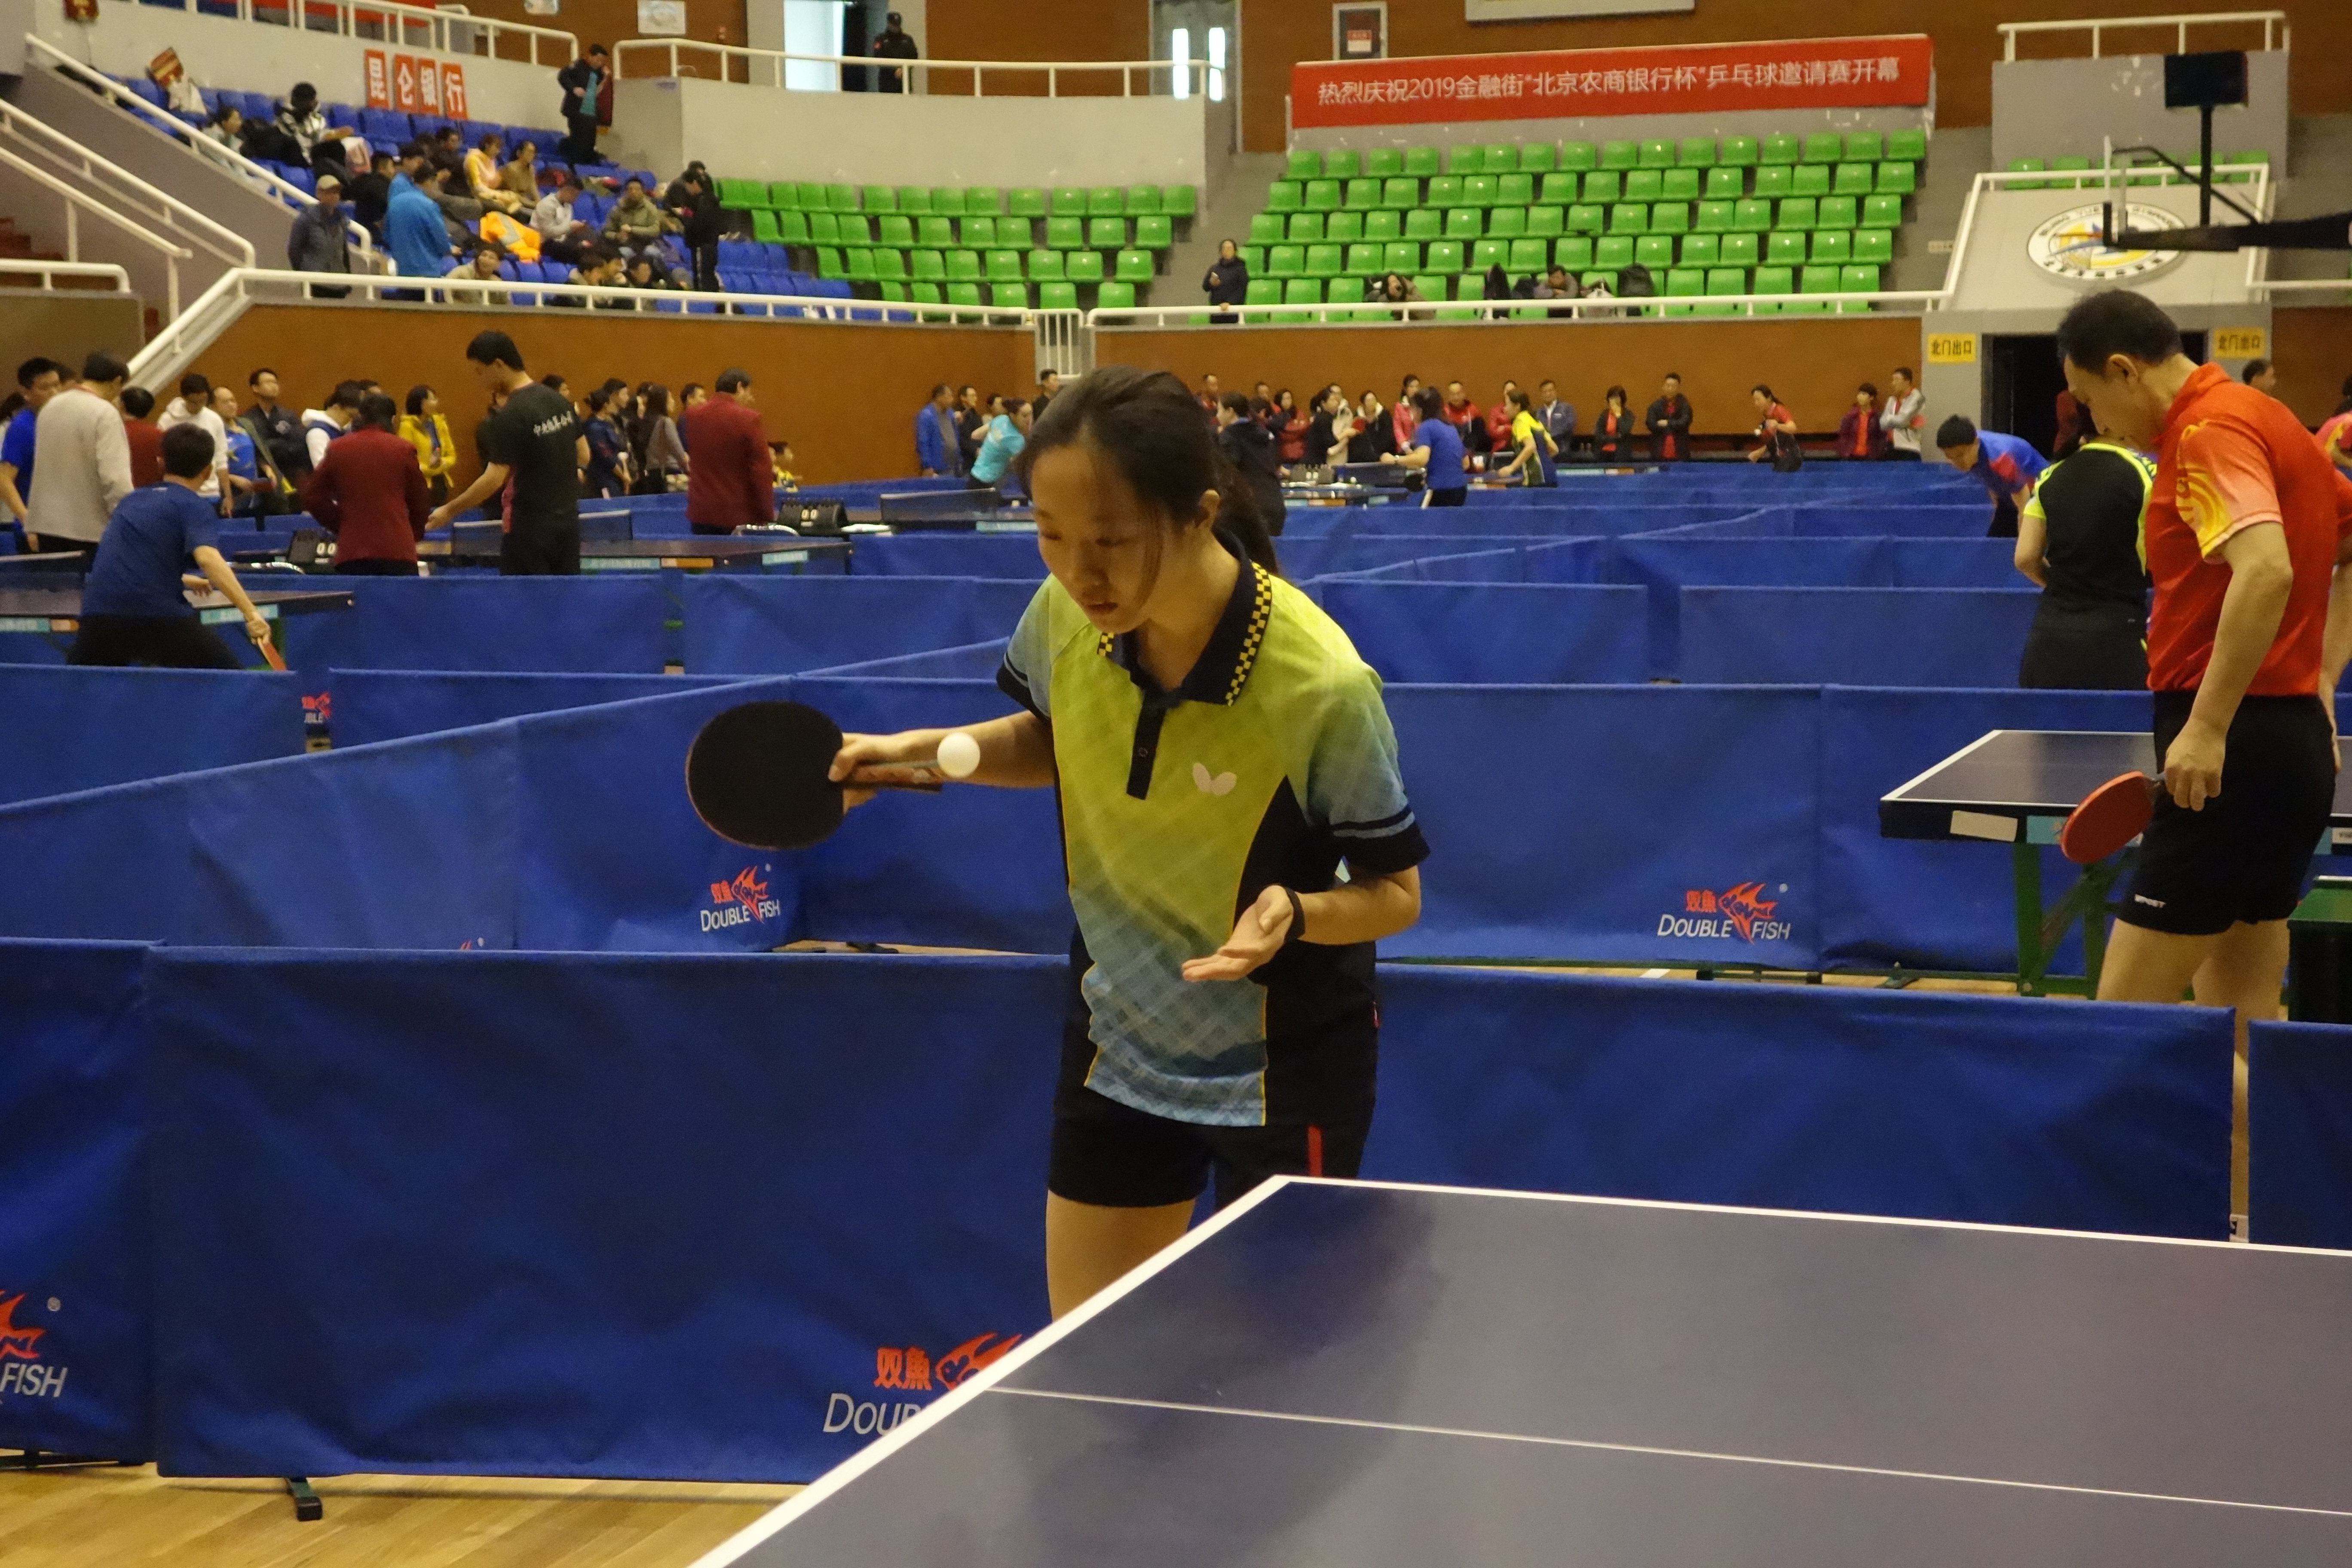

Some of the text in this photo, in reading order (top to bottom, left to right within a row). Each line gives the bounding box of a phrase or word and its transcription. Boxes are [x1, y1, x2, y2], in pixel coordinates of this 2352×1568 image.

[368, 57, 463, 112] 昆仑银行
[1931, 340, 1972, 355] 北门出口
[700, 899, 781, 932] DOUBLE FISH
[1657, 913, 1791, 940] DOUBLE FISH
[0, 1362, 68, 1398] FISH
